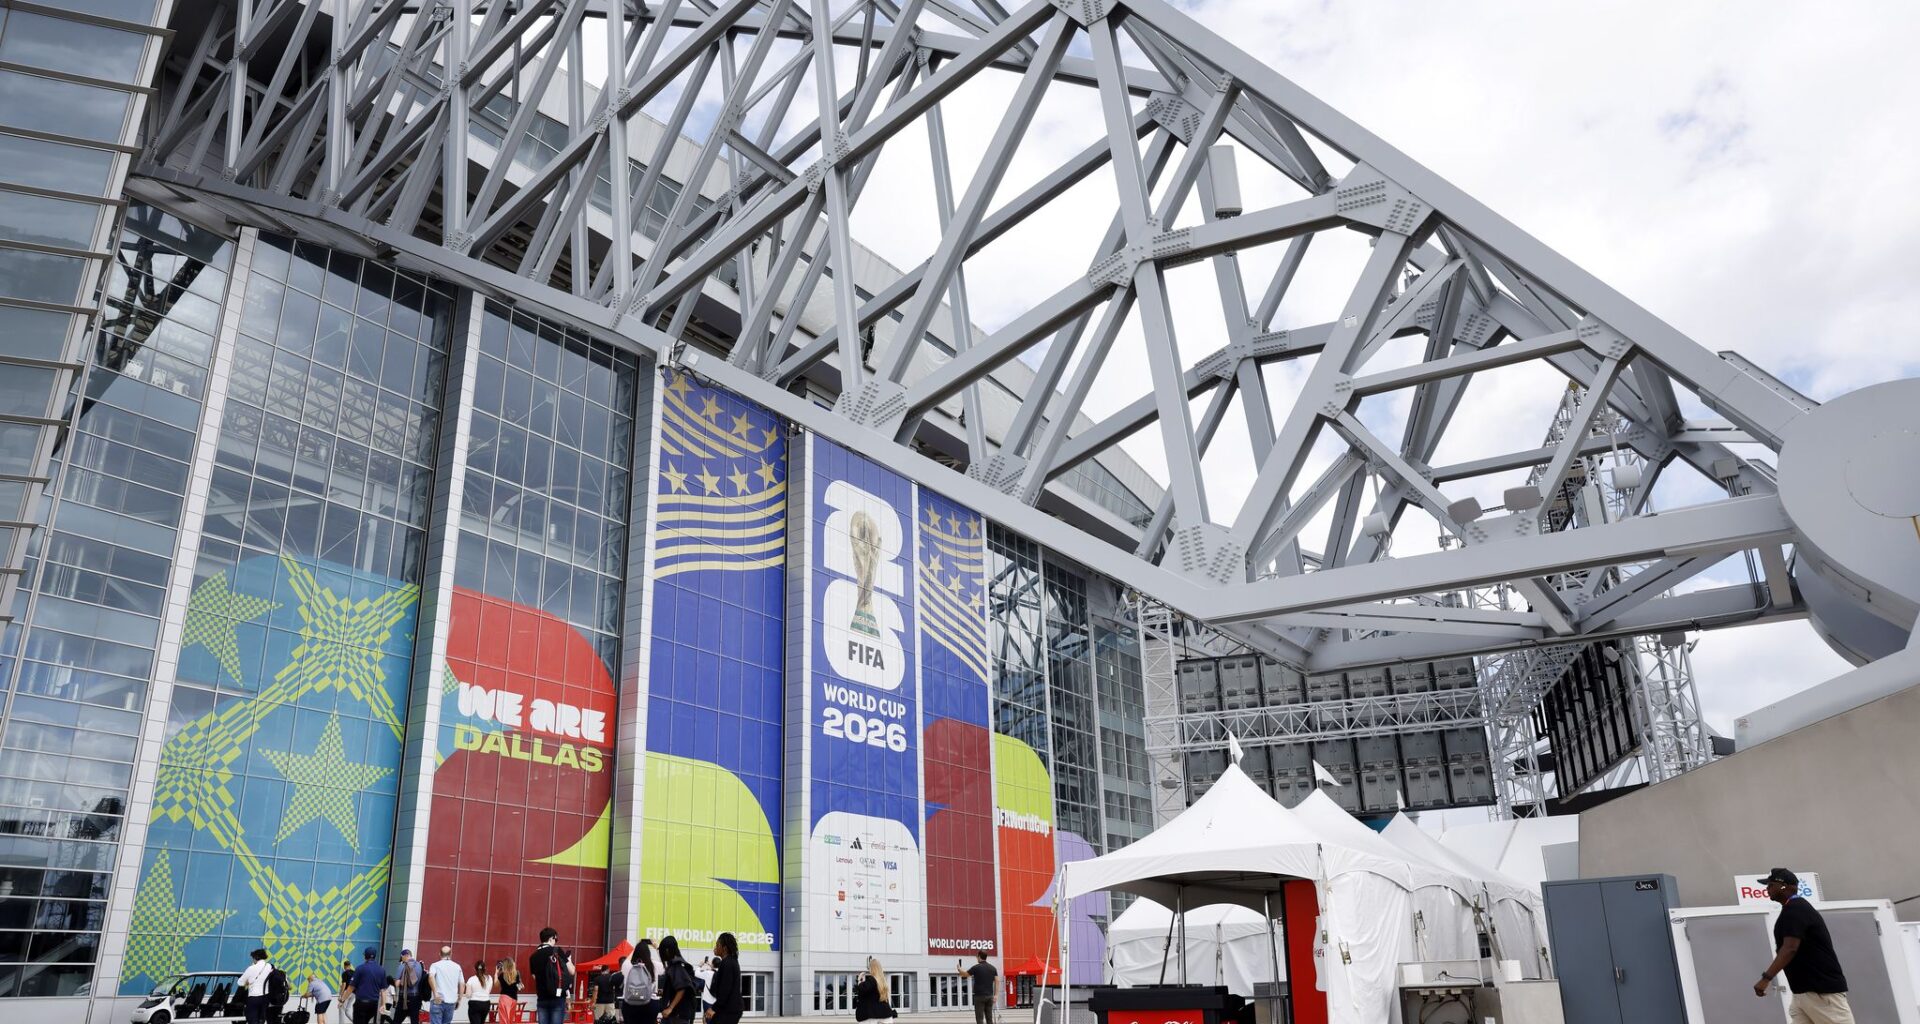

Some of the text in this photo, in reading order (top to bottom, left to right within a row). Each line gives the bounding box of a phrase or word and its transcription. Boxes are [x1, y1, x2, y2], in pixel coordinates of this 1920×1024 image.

[848, 640, 885, 670] FIFA
[458, 682, 605, 743] WE ARE
[823, 682, 906, 719] WORLD CUP
[823, 707, 907, 752] 2026
[454, 723, 603, 773] DALLAS
[883, 860, 898, 871] VISA
[673, 928, 714, 943] WORLD
[738, 931, 774, 944] 2026
[929, 937, 994, 950] WORLD CUP 2026
